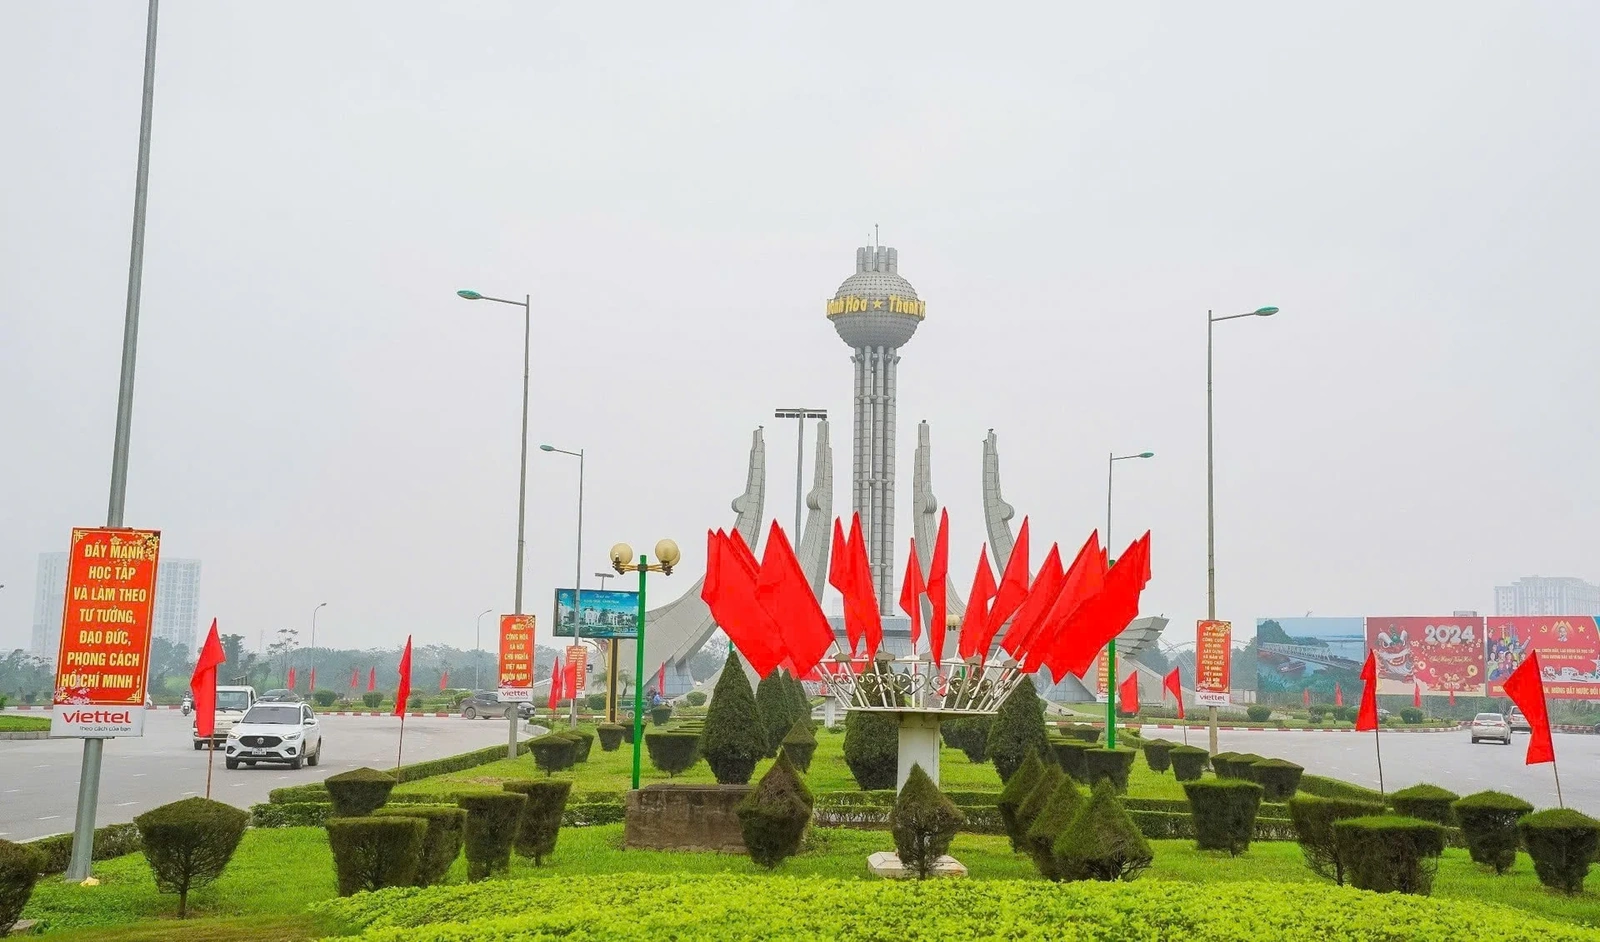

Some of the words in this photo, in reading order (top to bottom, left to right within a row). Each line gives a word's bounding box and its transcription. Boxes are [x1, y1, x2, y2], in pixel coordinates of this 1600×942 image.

[84, 540, 107, 558] ĐẨY
[110, 545, 144, 560] MẠNH
[88, 566, 112, 582] HỌC
[114, 562, 136, 583] TẬP
[74, 584, 88, 600] VÀ
[91, 586, 115, 600] LÀM
[119, 588, 146, 602] THEO
[80, 608, 95, 622] TƯ
[96, 606, 136, 624] TƯỞNG,
[80, 630, 102, 646] ĐẠO
[106, 628, 131, 646] ĐỨC,
[1424, 624, 1475, 644] 2024
[67, 652, 106, 666] PHONG
[110, 650, 140, 666] CÁCH
[62, 668, 78, 688] HỒ
[80, 672, 100, 688] CHÍ
[102, 674, 133, 688] MINH
[62, 710, 132, 724] viettel
